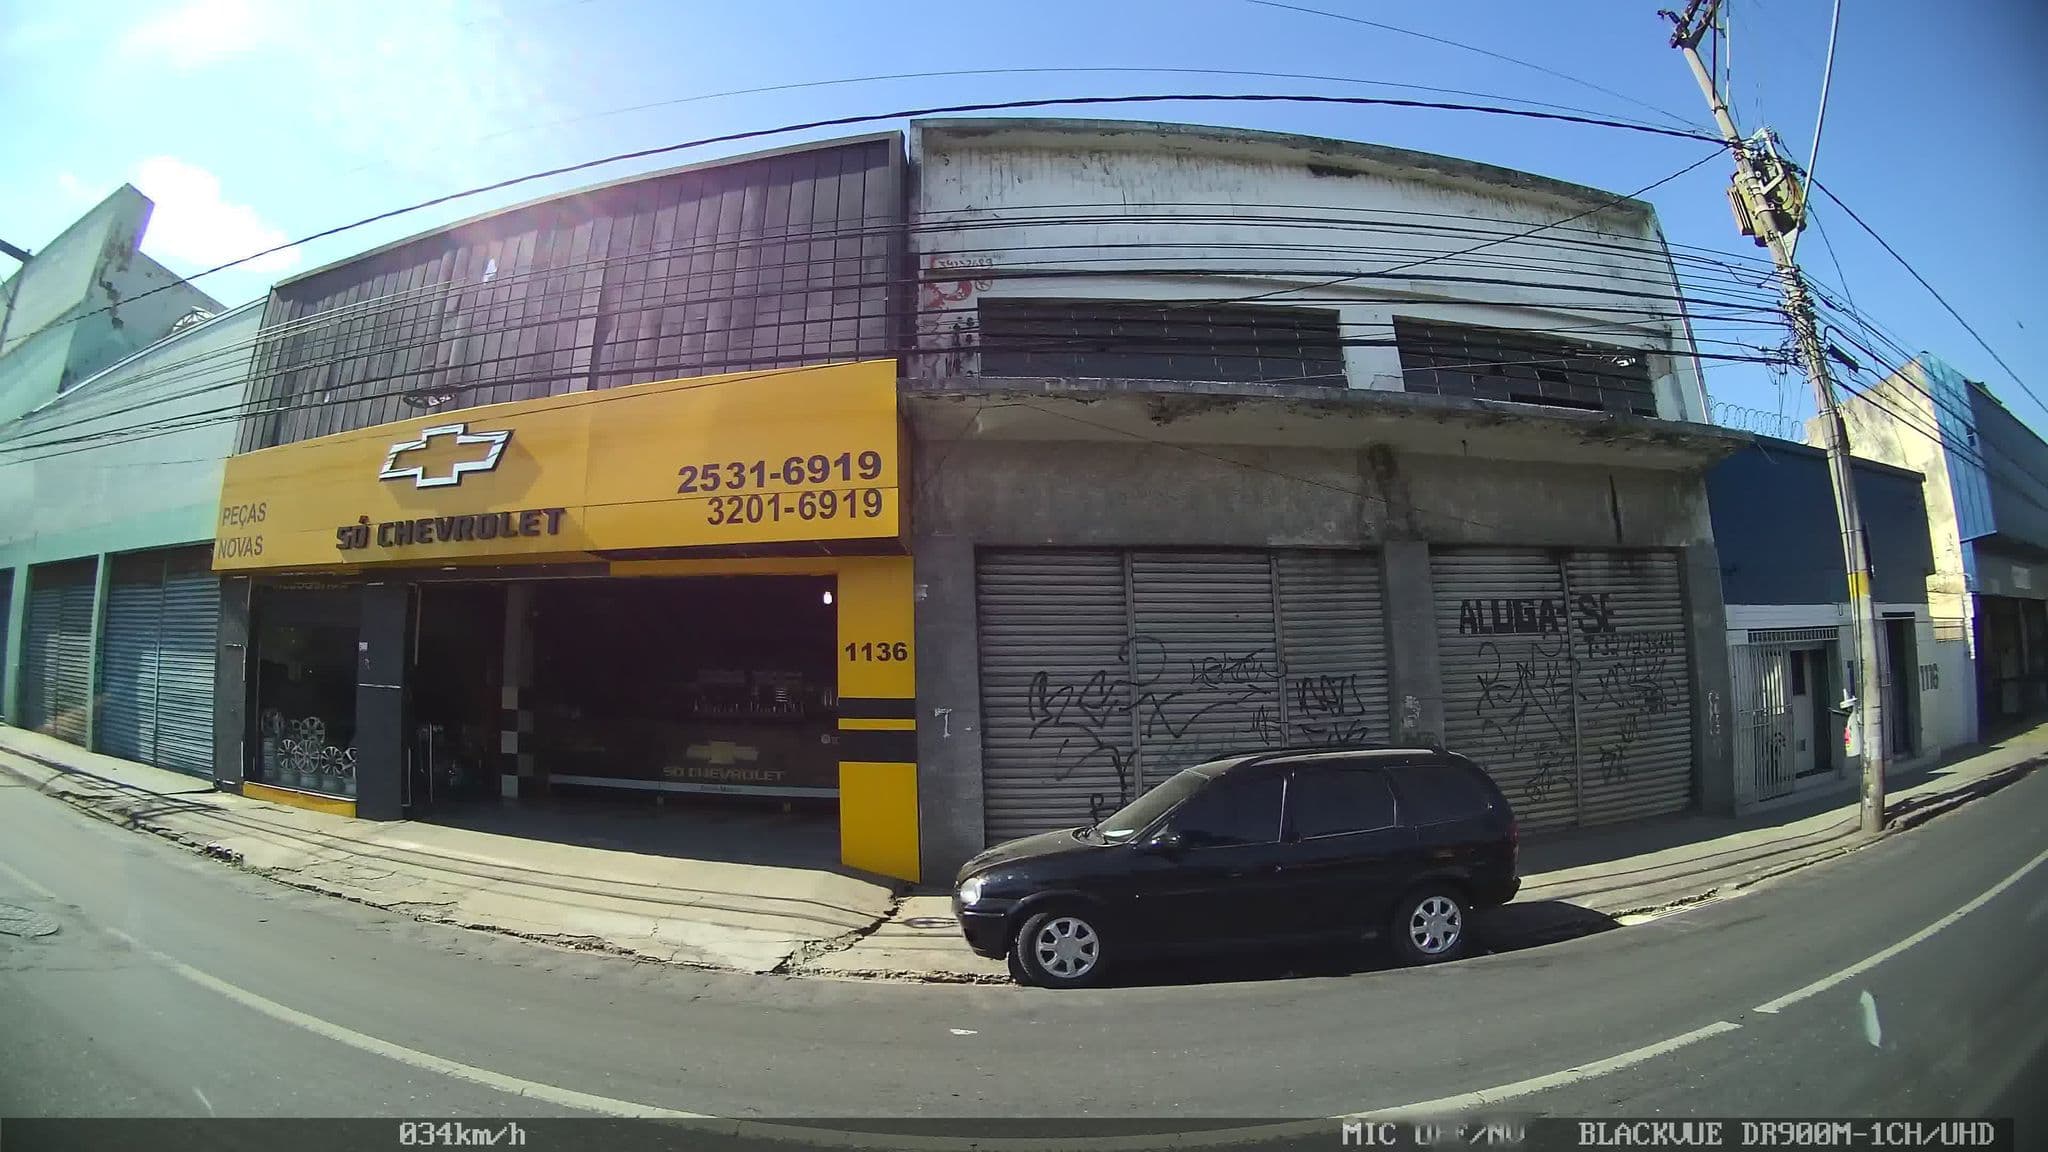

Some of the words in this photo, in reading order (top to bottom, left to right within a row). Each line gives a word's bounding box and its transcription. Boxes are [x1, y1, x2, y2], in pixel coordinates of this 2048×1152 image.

[677, 450, 882, 494] 2531-6919
[222, 502, 267, 529] PEÇAS
[707, 488, 883, 526] 3201-6919
[336, 515, 369, 550] SÓ
[377, 507, 566, 548] CHEVROLET
[217, 535, 263, 559] NOVAS
[845, 642, 908, 662] 1136
